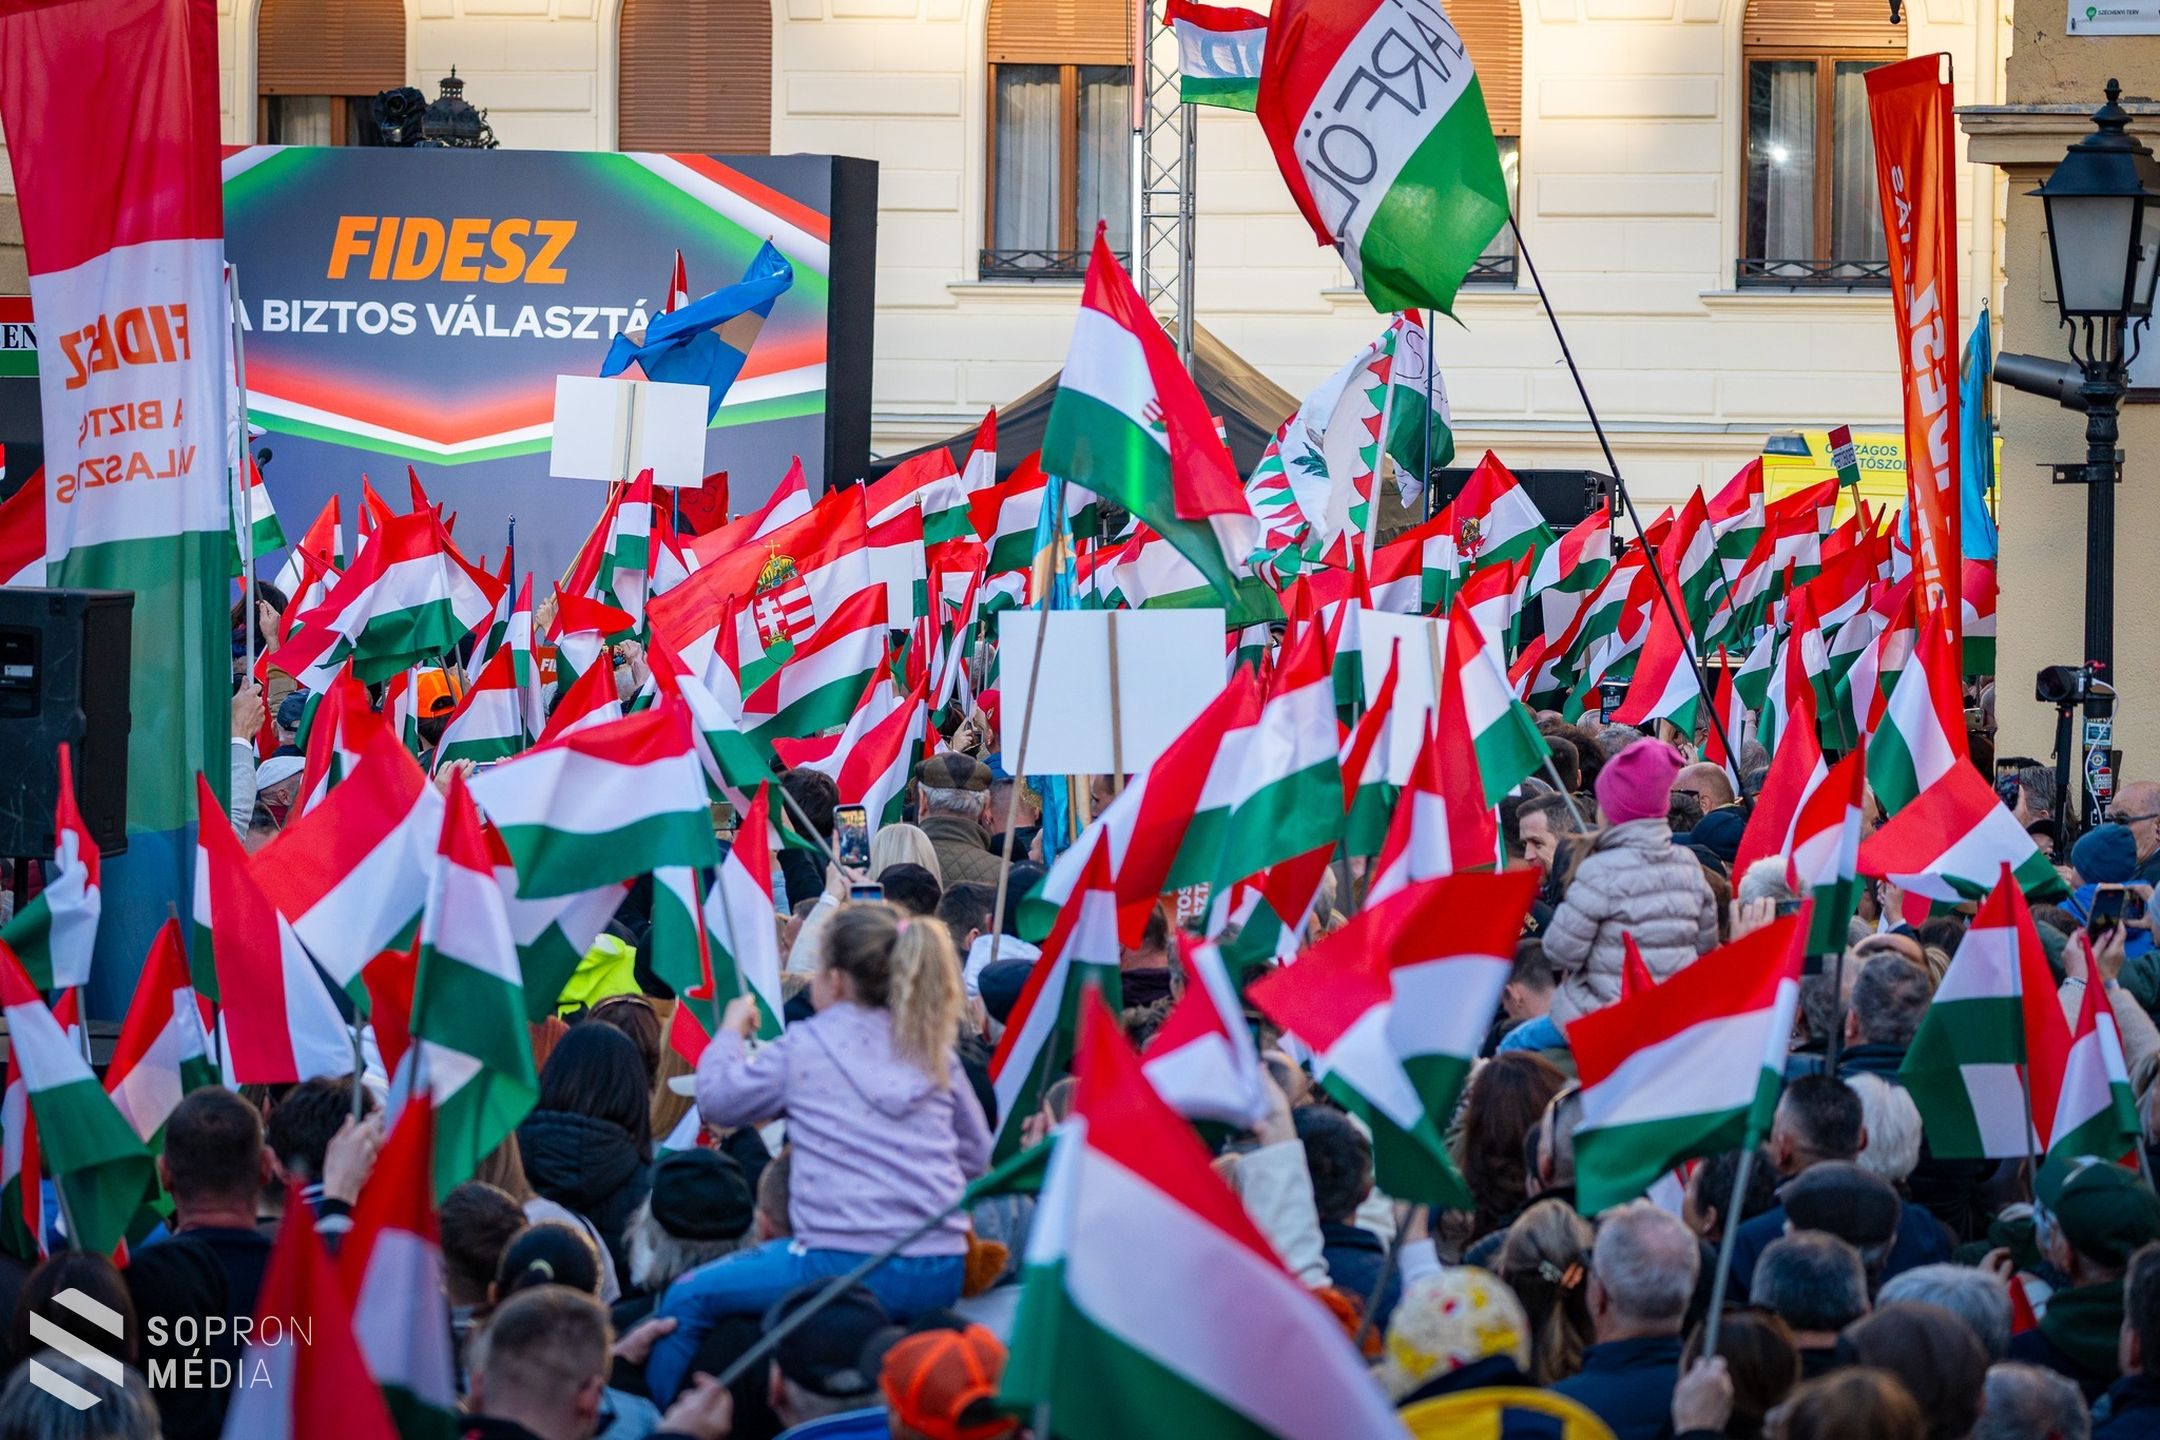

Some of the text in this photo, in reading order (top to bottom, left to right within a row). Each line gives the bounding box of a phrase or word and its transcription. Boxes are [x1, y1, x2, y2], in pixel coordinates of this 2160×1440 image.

[327, 215, 577, 285] FIDESZ
[263, 299, 417, 335] BIZTOS
[425, 294, 650, 340] VÁLASZTÁ
